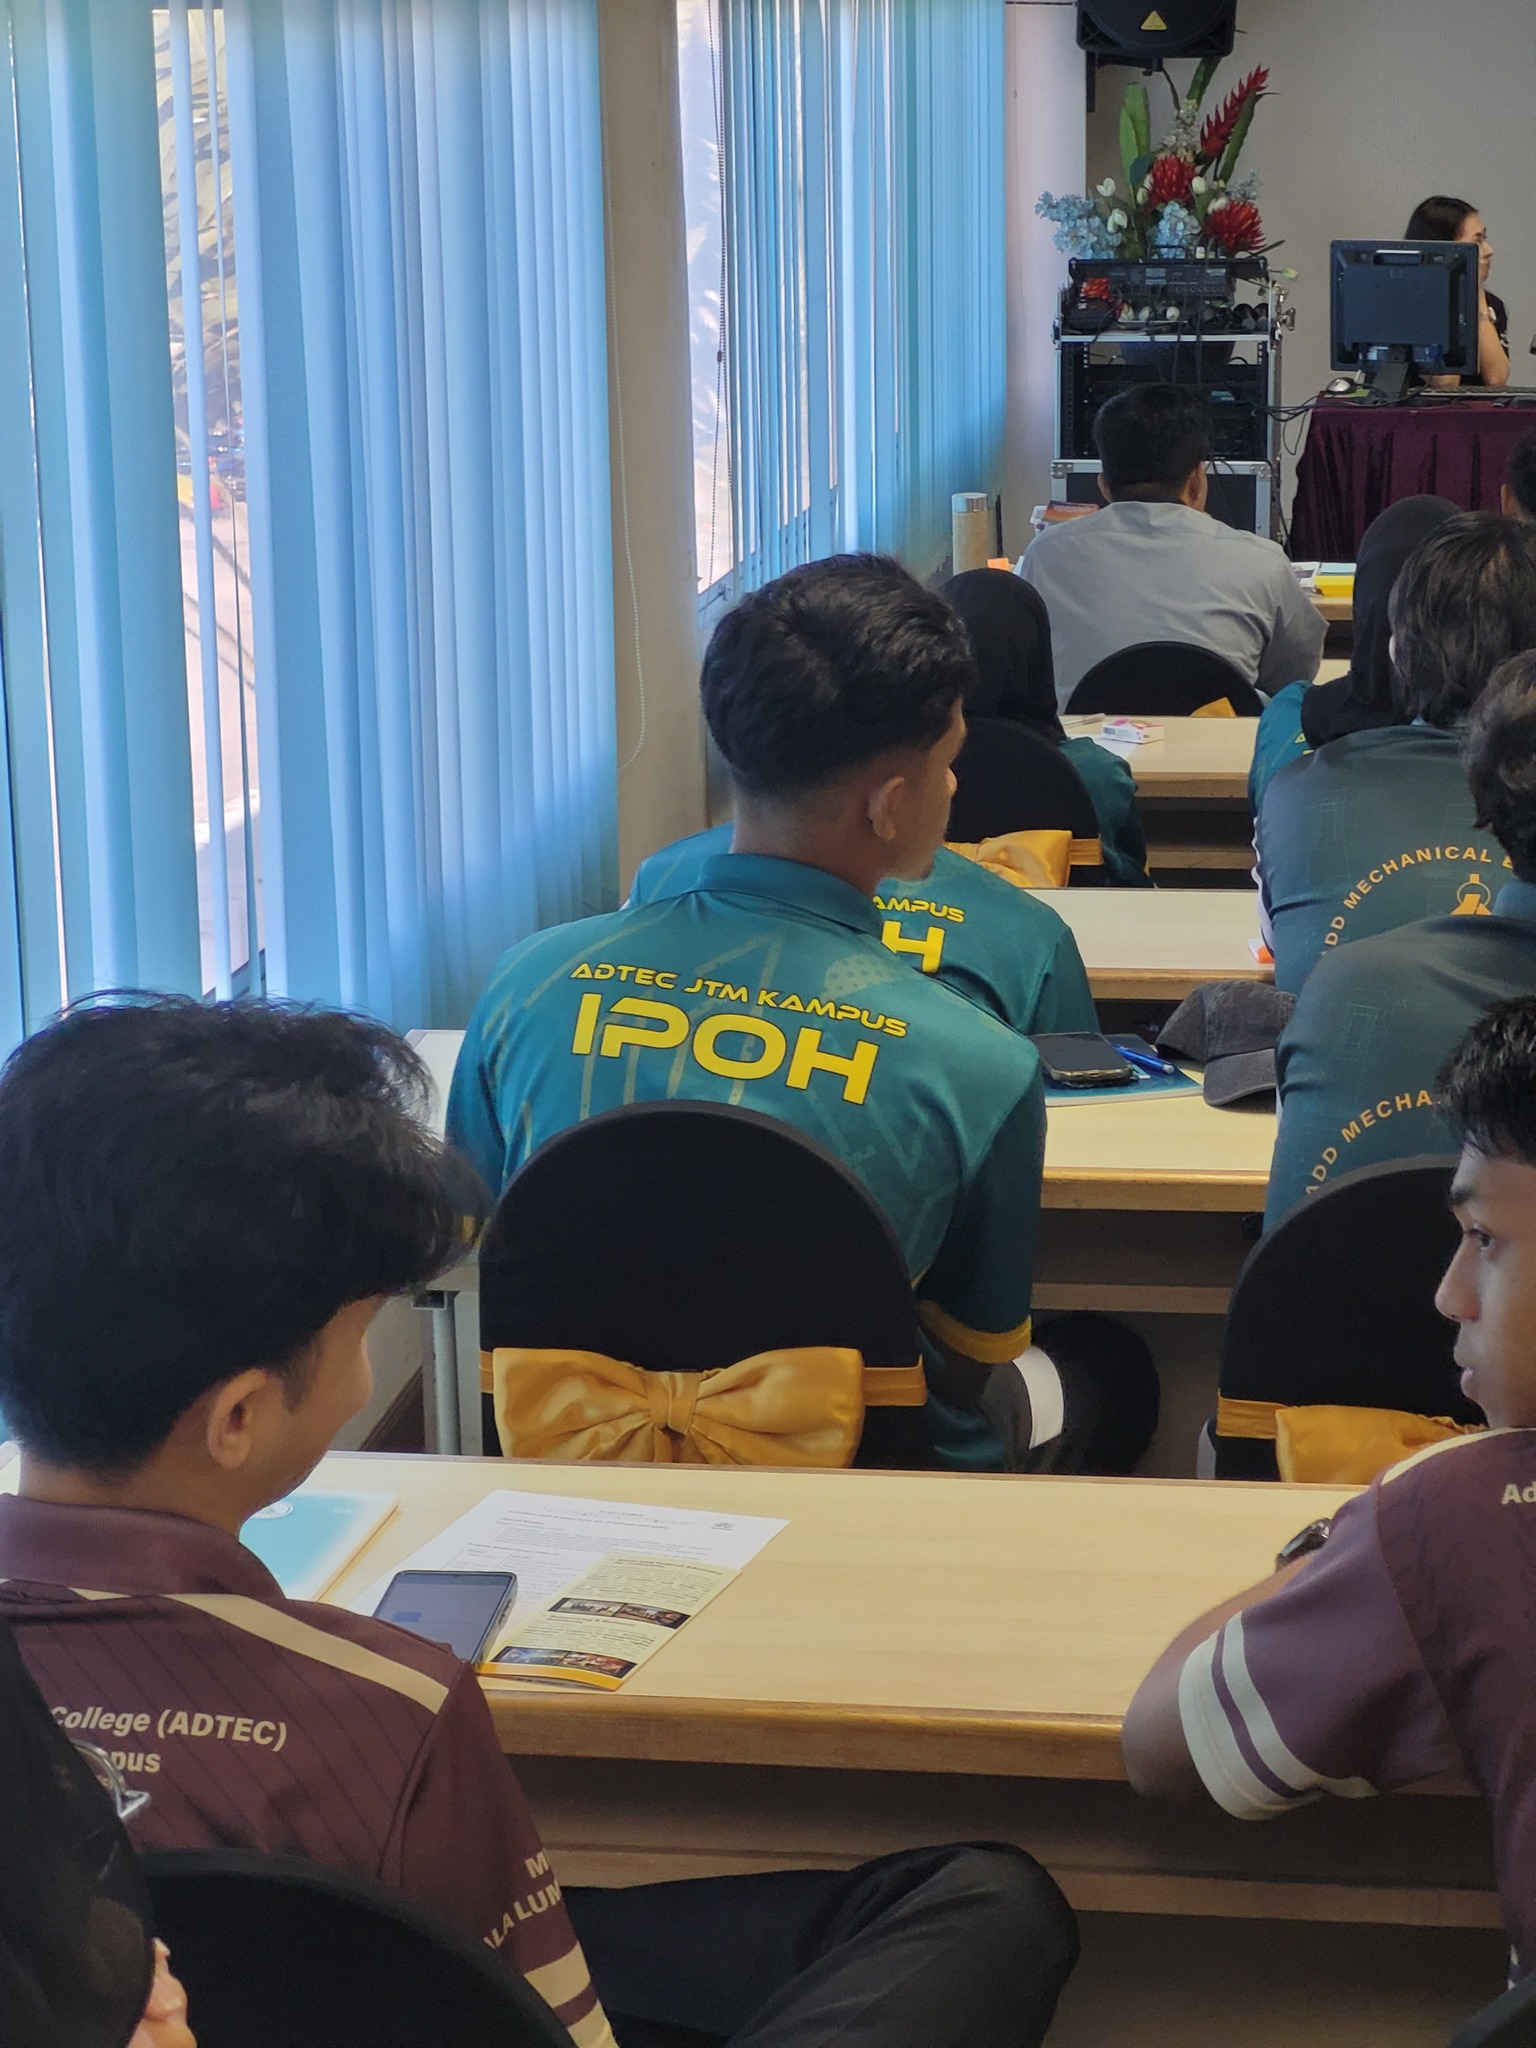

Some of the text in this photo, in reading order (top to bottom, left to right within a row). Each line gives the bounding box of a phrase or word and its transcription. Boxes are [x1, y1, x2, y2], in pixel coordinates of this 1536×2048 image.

[1321, 846, 1492, 955] DD MECHANICAL
[570, 962, 908, 1037] ADTEC JTM KAMPUS
[571, 993, 880, 1105] IPOH
[157, 1709, 287, 1752] (ADTEC)
